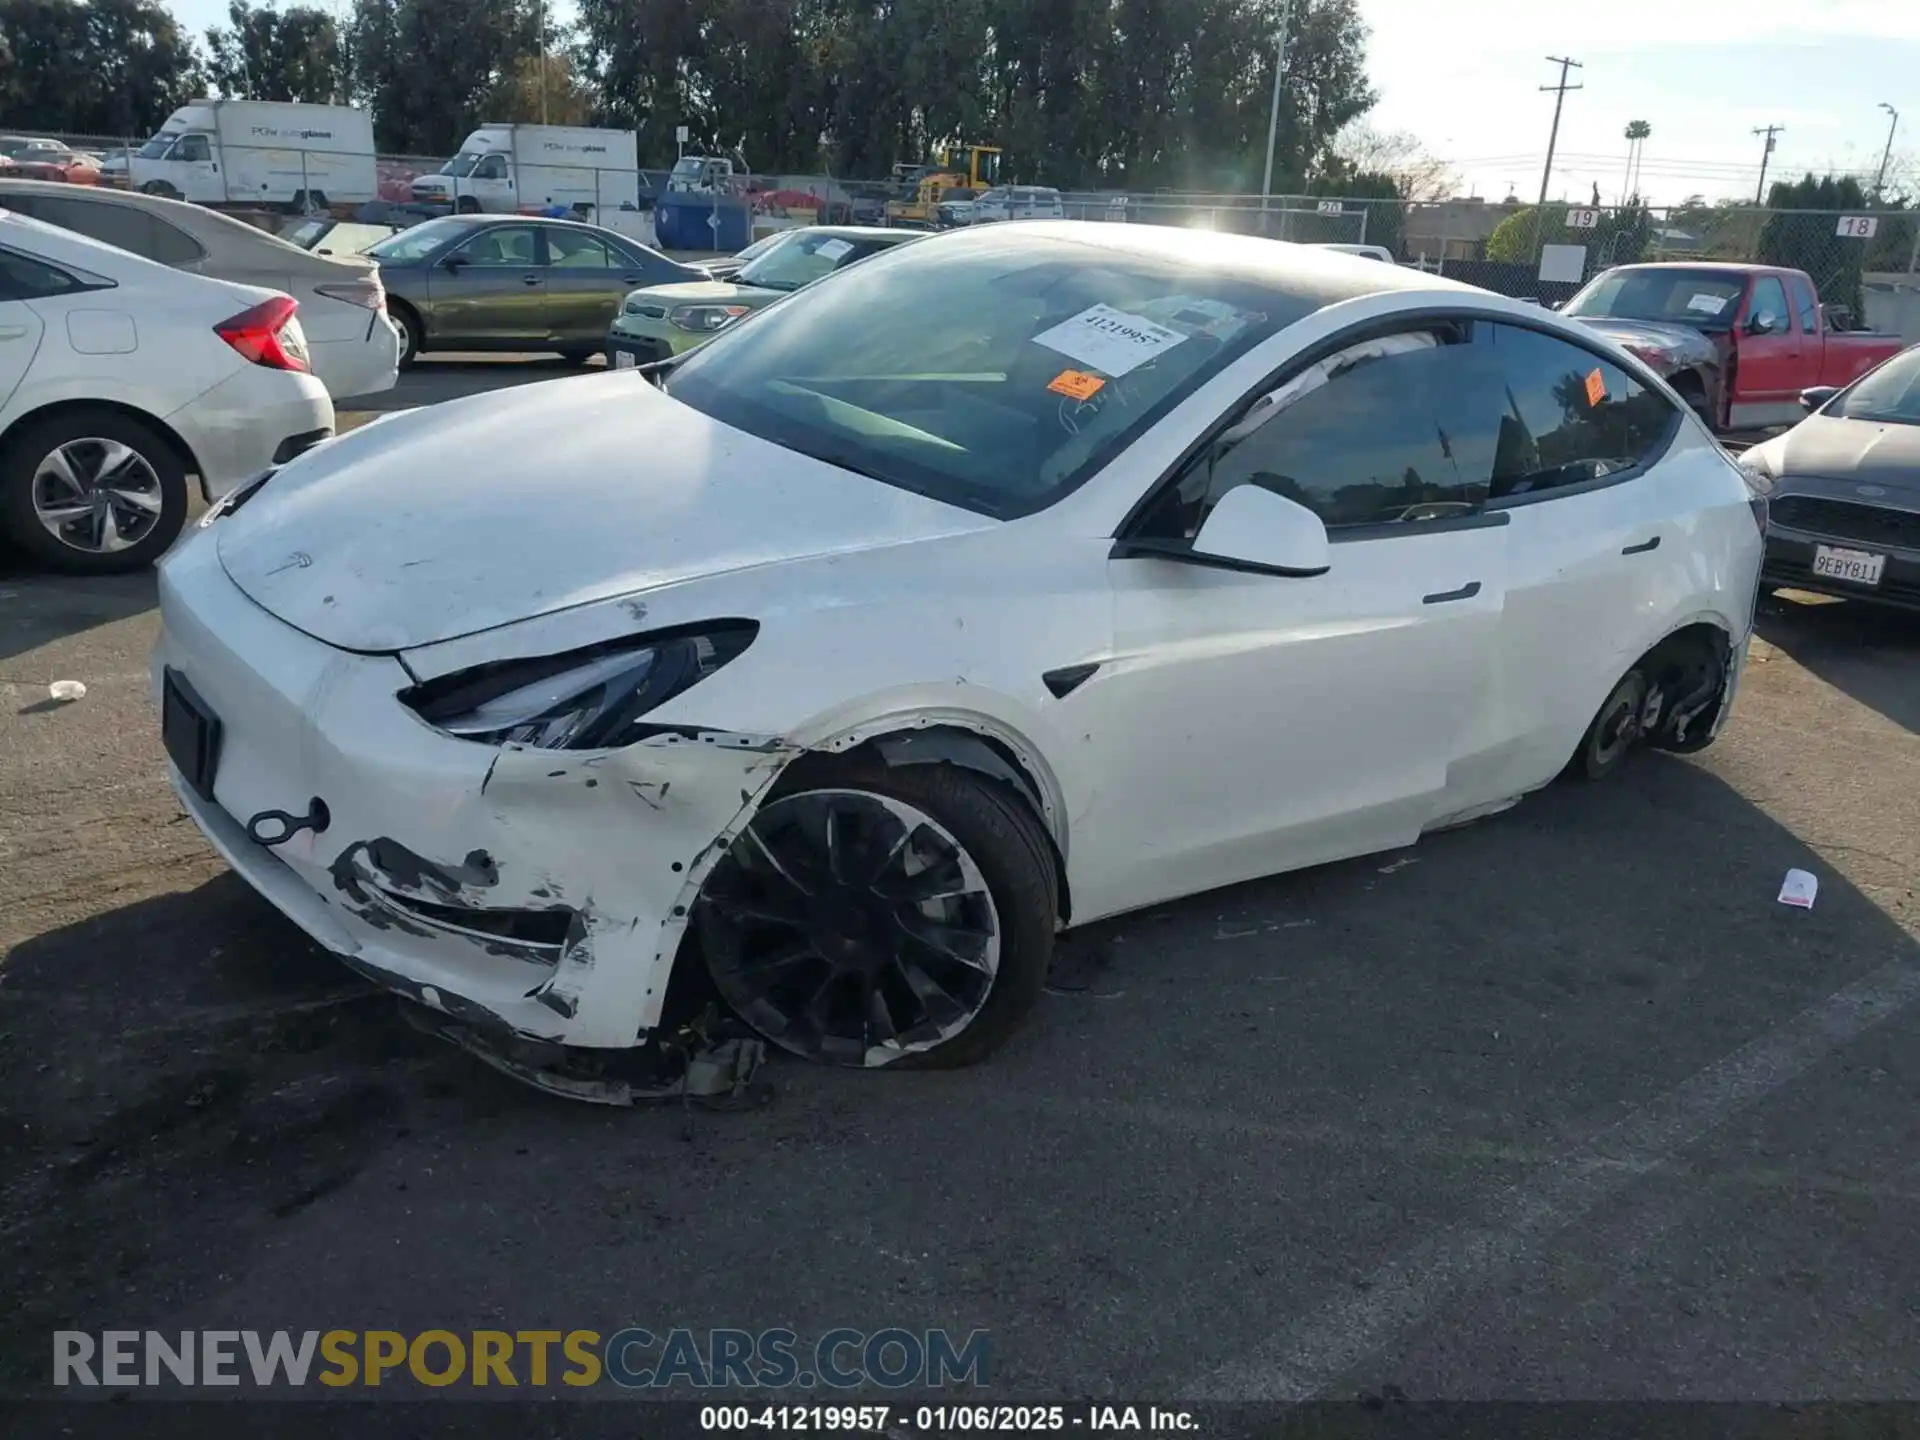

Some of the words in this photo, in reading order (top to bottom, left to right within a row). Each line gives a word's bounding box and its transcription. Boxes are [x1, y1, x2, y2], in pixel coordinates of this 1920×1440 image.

[1573, 211, 1592, 225] 19
[1846, 219, 1869, 235] 18
[1085, 315, 1161, 345] 41219957
[1817, 556, 1877, 580] 9EBY811
